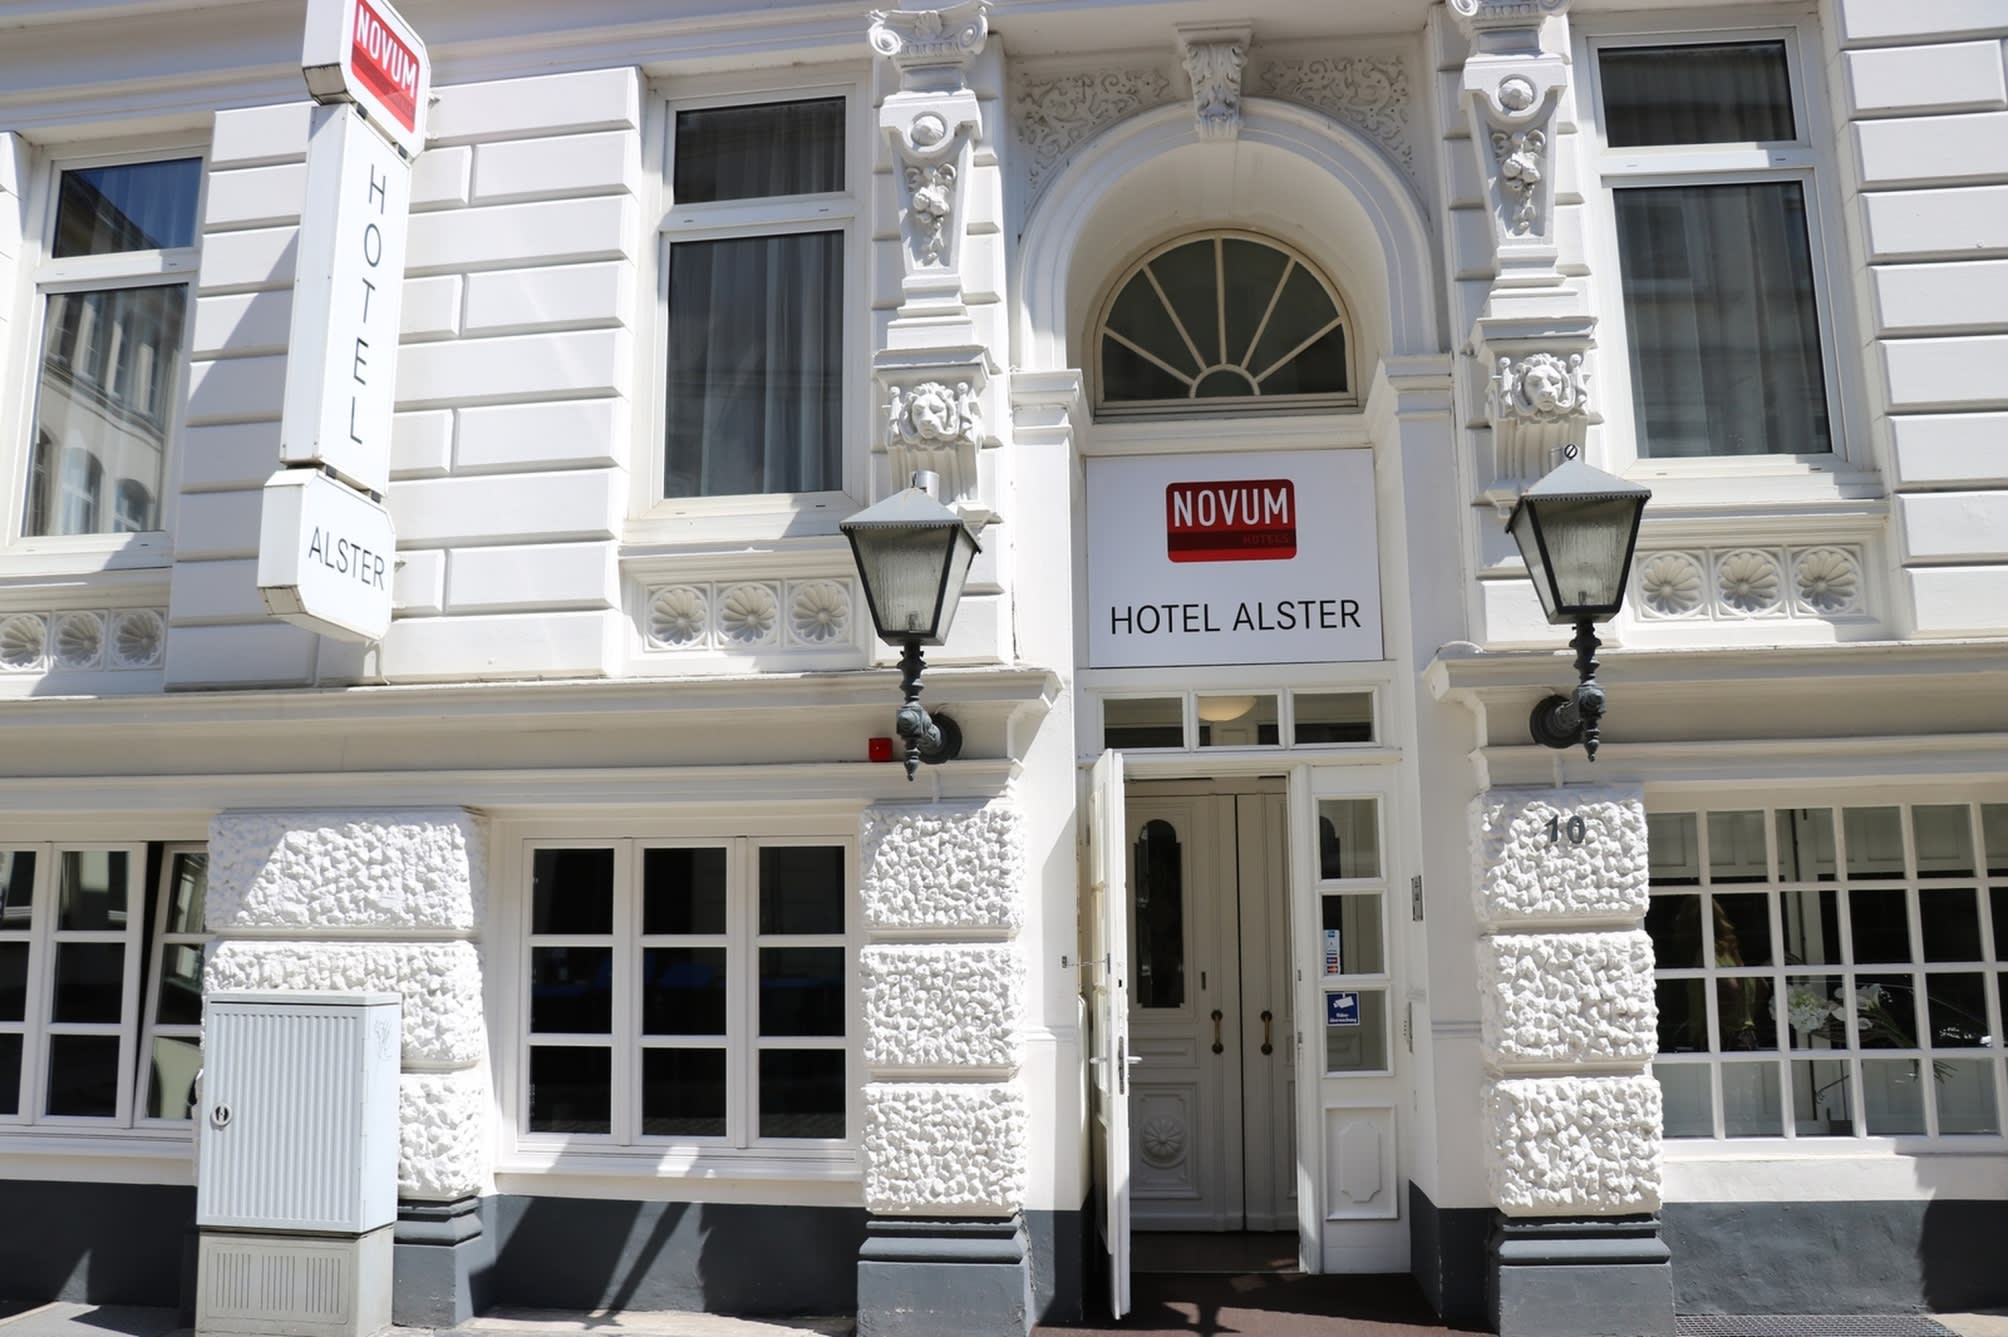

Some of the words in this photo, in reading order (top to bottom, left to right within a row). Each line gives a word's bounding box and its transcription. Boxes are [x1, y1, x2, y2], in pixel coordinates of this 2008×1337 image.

[357, 3, 417, 99] NOVUM
[350, 164, 386, 445] HOTEL
[1173, 487, 1289, 527] NOVUM
[308, 525, 386, 591] ALSTER
[1243, 534, 1289, 545] HOTELS
[1110, 603, 1221, 635] HOTEL
[1232, 599, 1362, 632] ALSTER
[1544, 814, 1586, 844] 10
